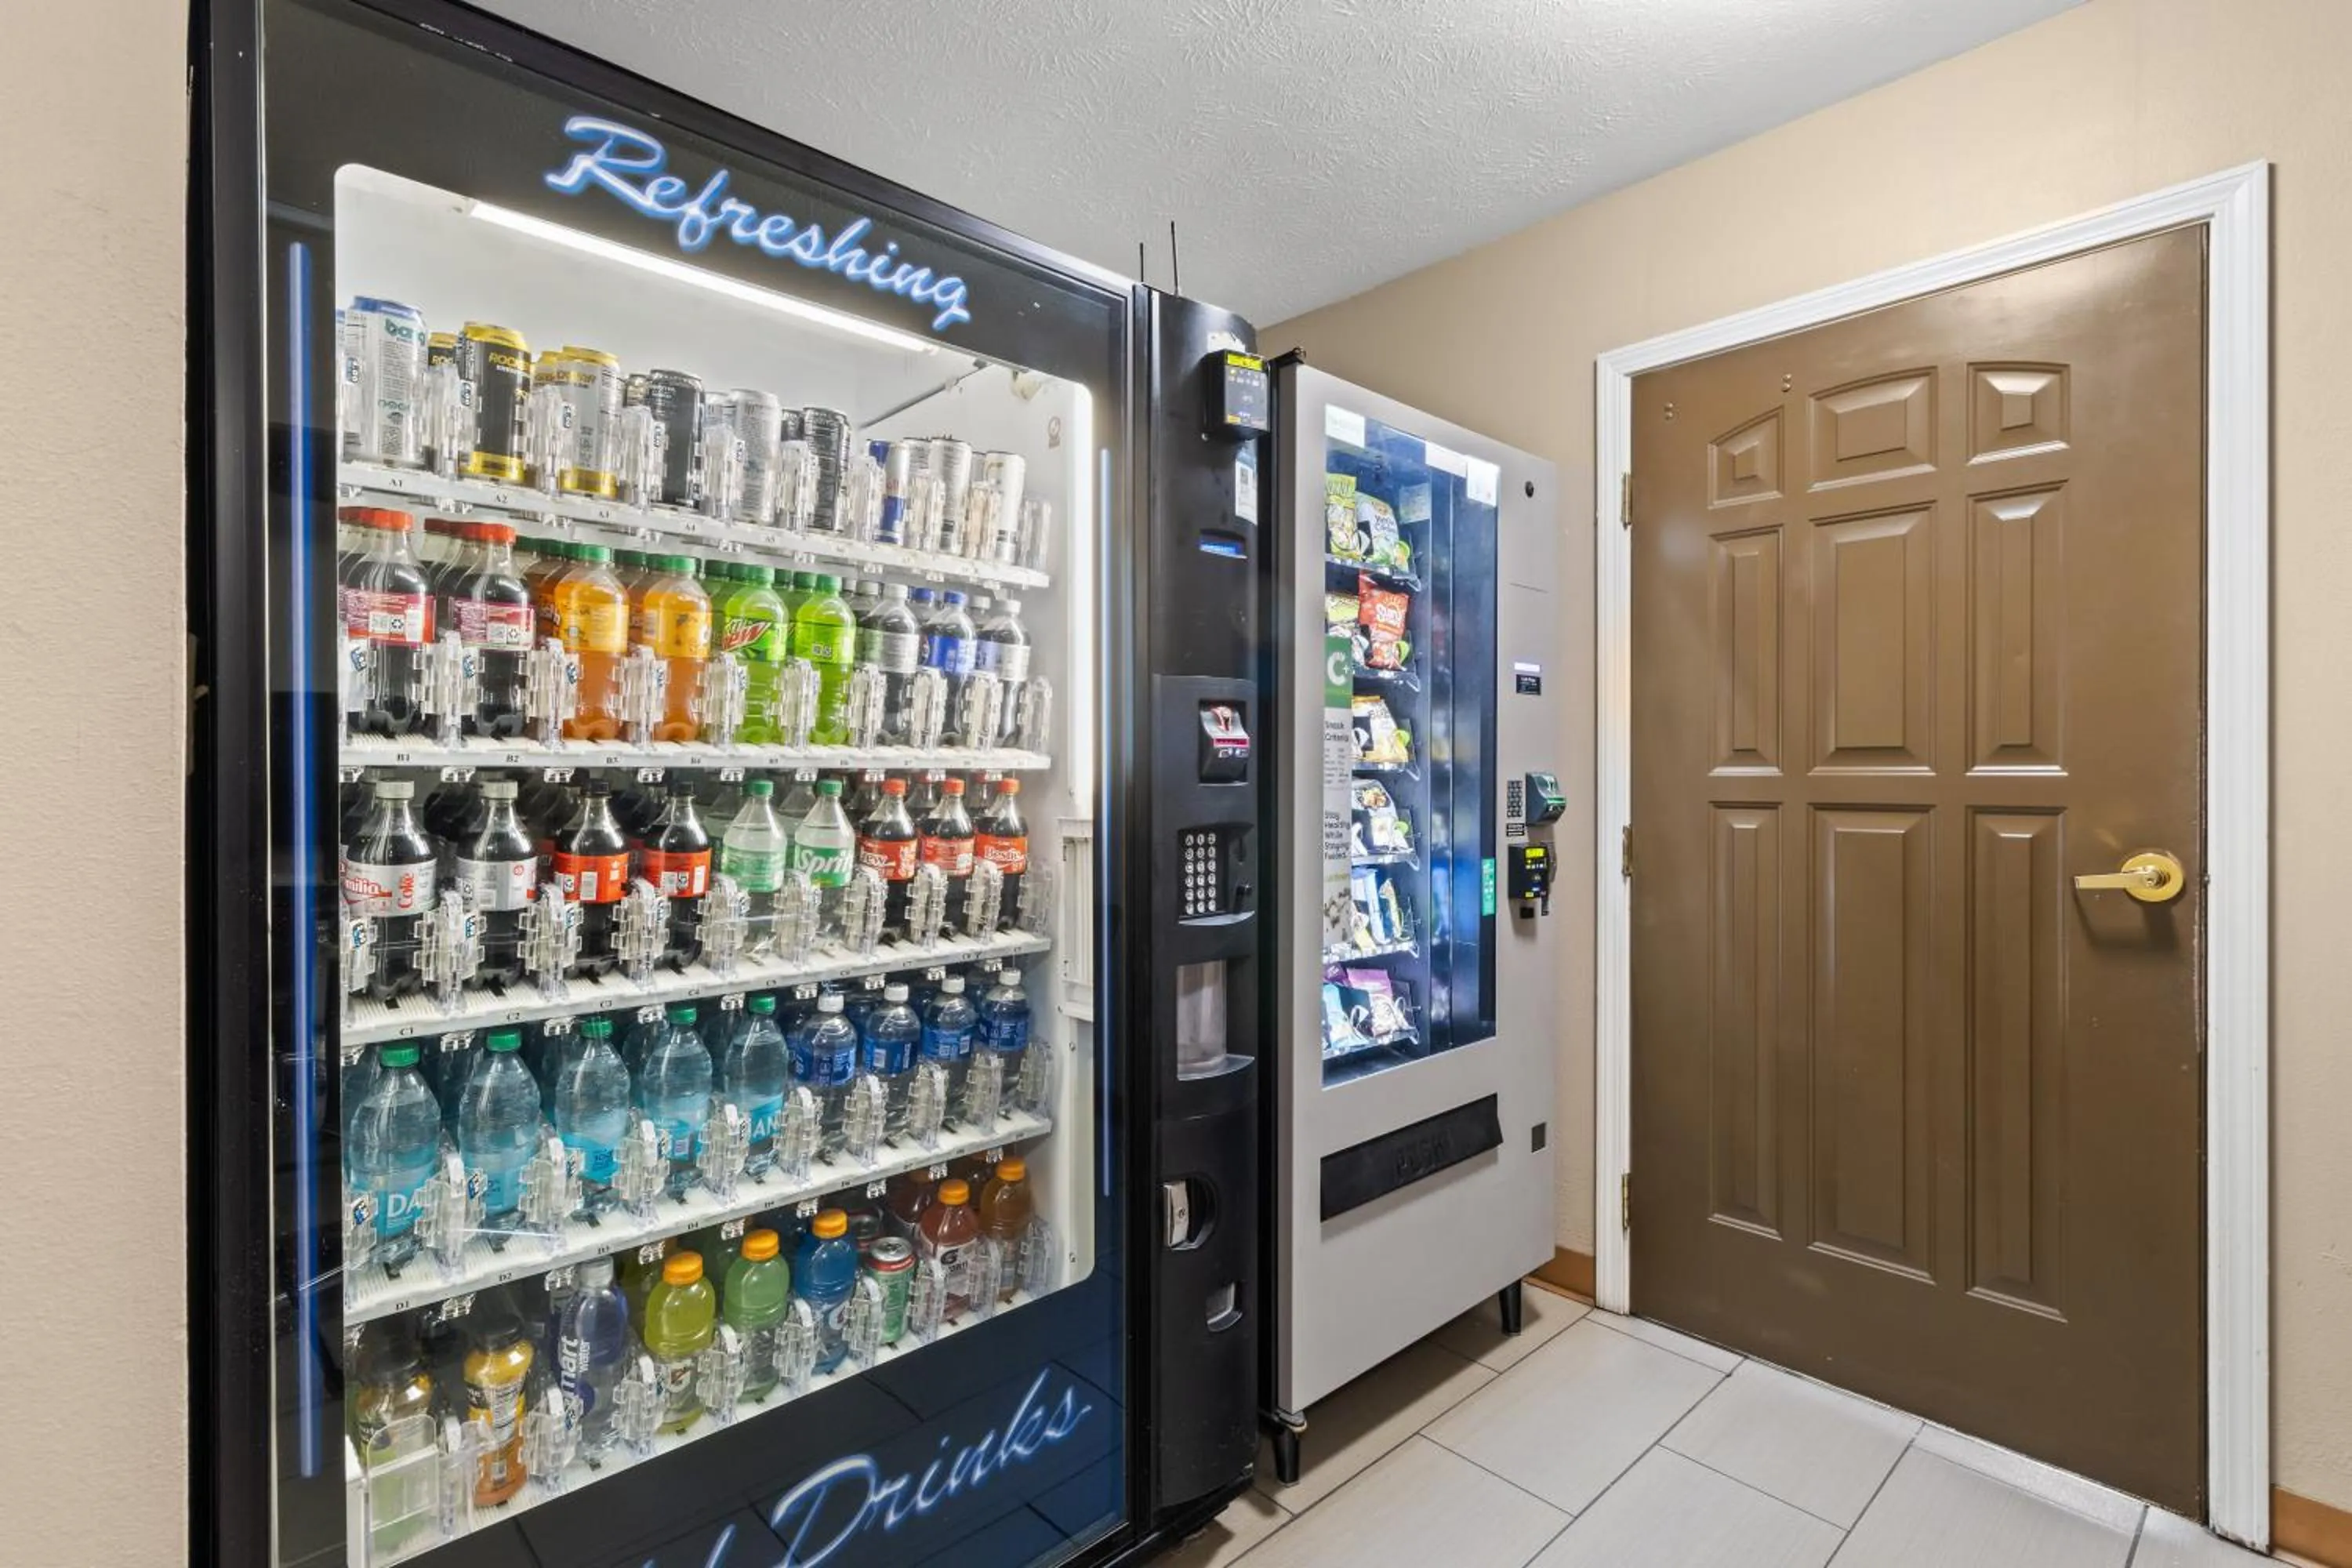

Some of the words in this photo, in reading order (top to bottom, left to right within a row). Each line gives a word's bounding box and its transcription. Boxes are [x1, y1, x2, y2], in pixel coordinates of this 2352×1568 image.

[545, 116, 971, 330] Refreshing
[385, 318, 426, 346] bag
[495, 494, 508, 503] A2
[396, 1300, 409, 1311] D1
[771, 1367, 1092, 1568] Drinks
